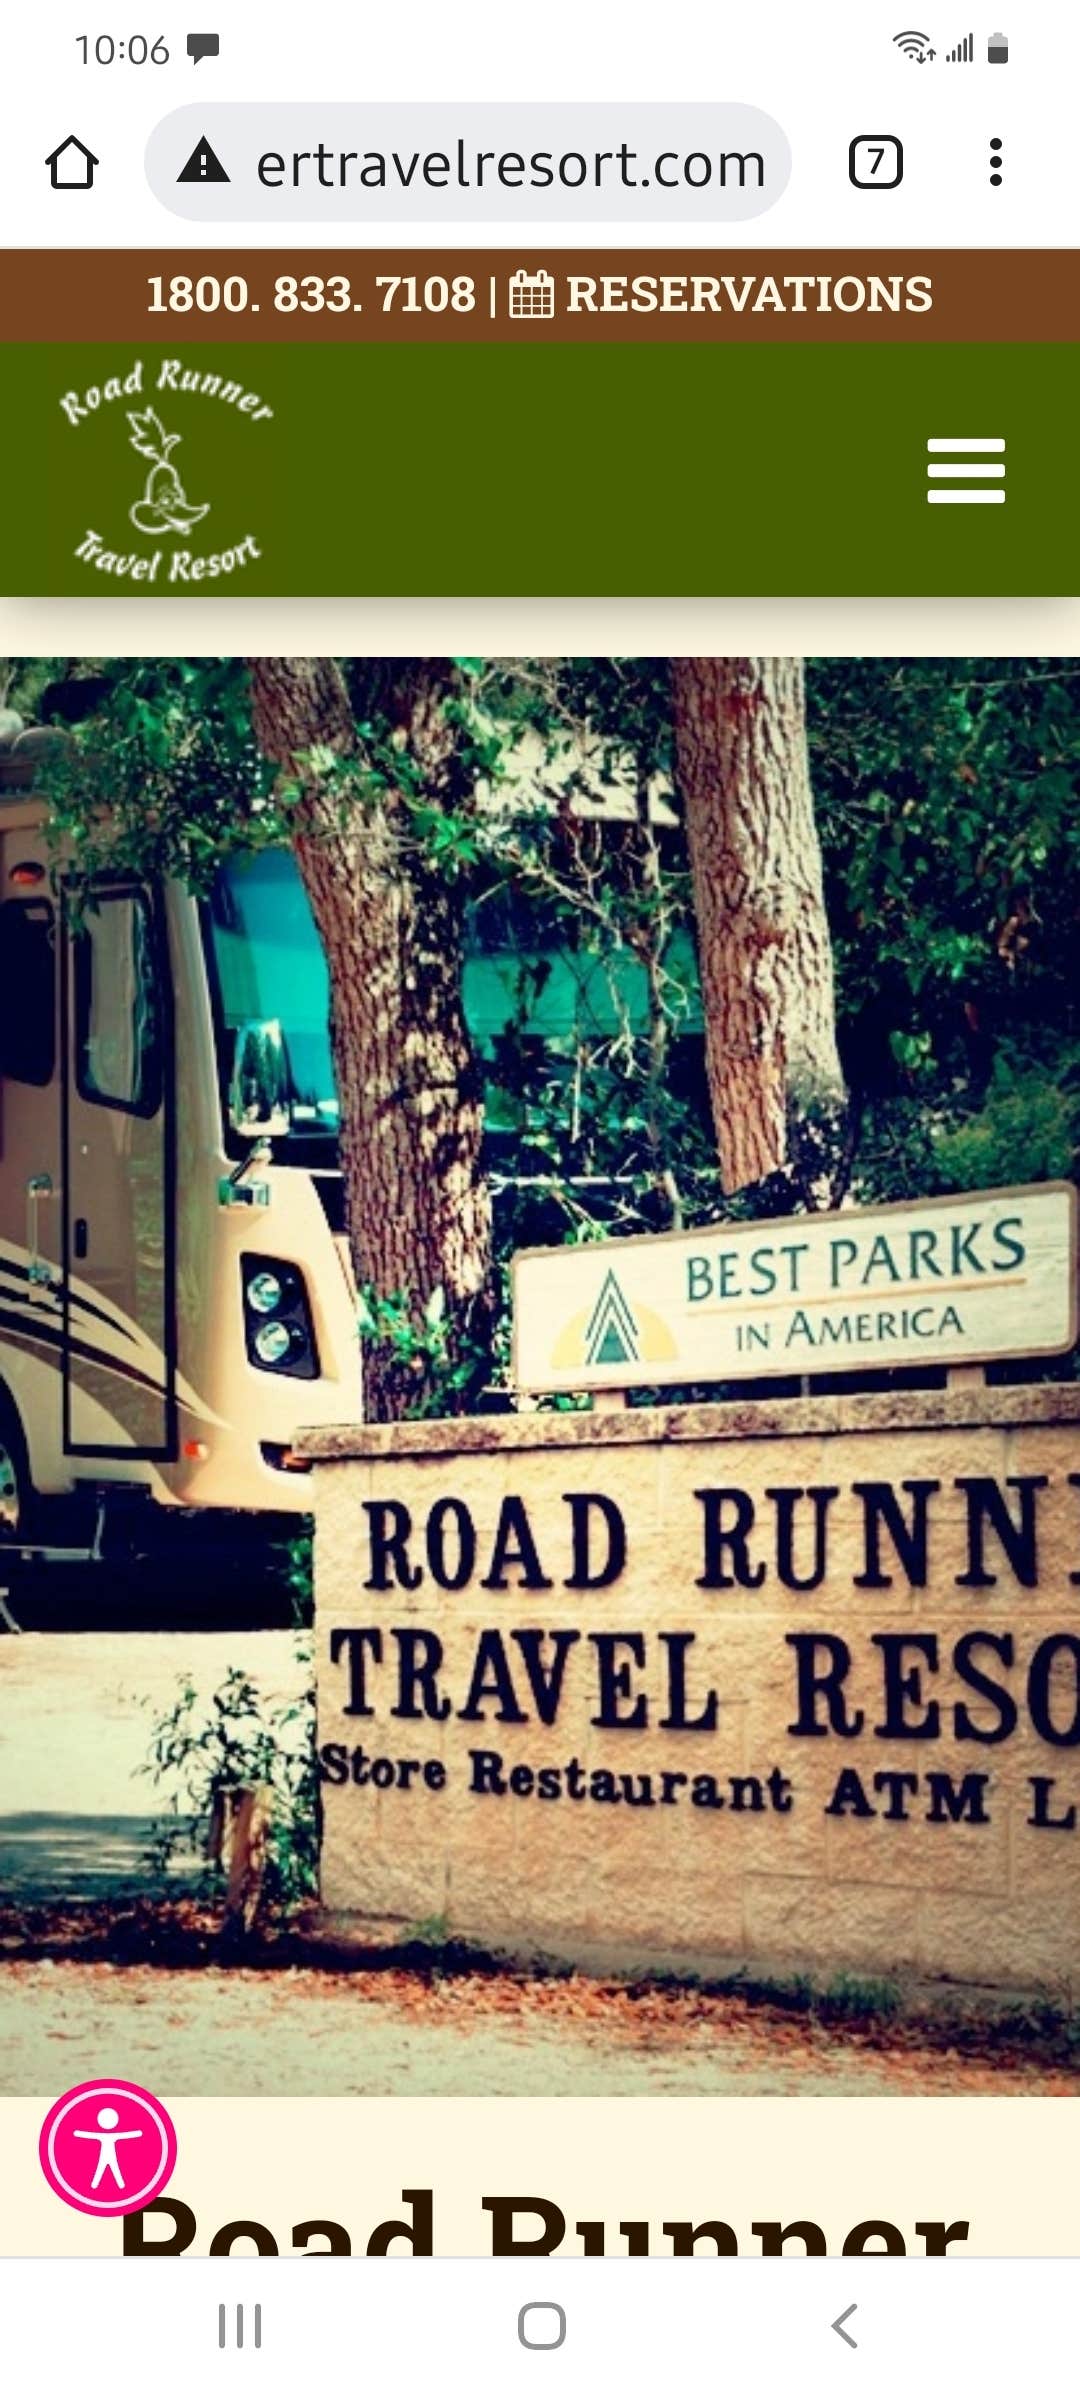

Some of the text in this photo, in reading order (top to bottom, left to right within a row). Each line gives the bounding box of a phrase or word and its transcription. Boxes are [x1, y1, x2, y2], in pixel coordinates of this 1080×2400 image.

[75, 34, 170, 65] 10:06
[257, 138, 765, 188] ertravelresort.com
[867, 148, 885, 175] 7
[147, 275, 260, 313] 1800.
[273, 275, 362, 313] 833.
[375, 275, 476, 313] 7108
[566, 275, 933, 313] RESERVATIONS
[59, 358, 274, 426] Road Runner
[74, 529, 263, 583] Travel Resort
[687, 1217, 1026, 1302] BEST PARKS
[361, 1493, 627, 1592] ROAD
[329, 1627, 1080, 1752] TRAVEL RESO
[320, 1743, 447, 1791] Store
[467, 1748, 794, 1814] Restaurant
[822, 1767, 992, 1827] ATM
